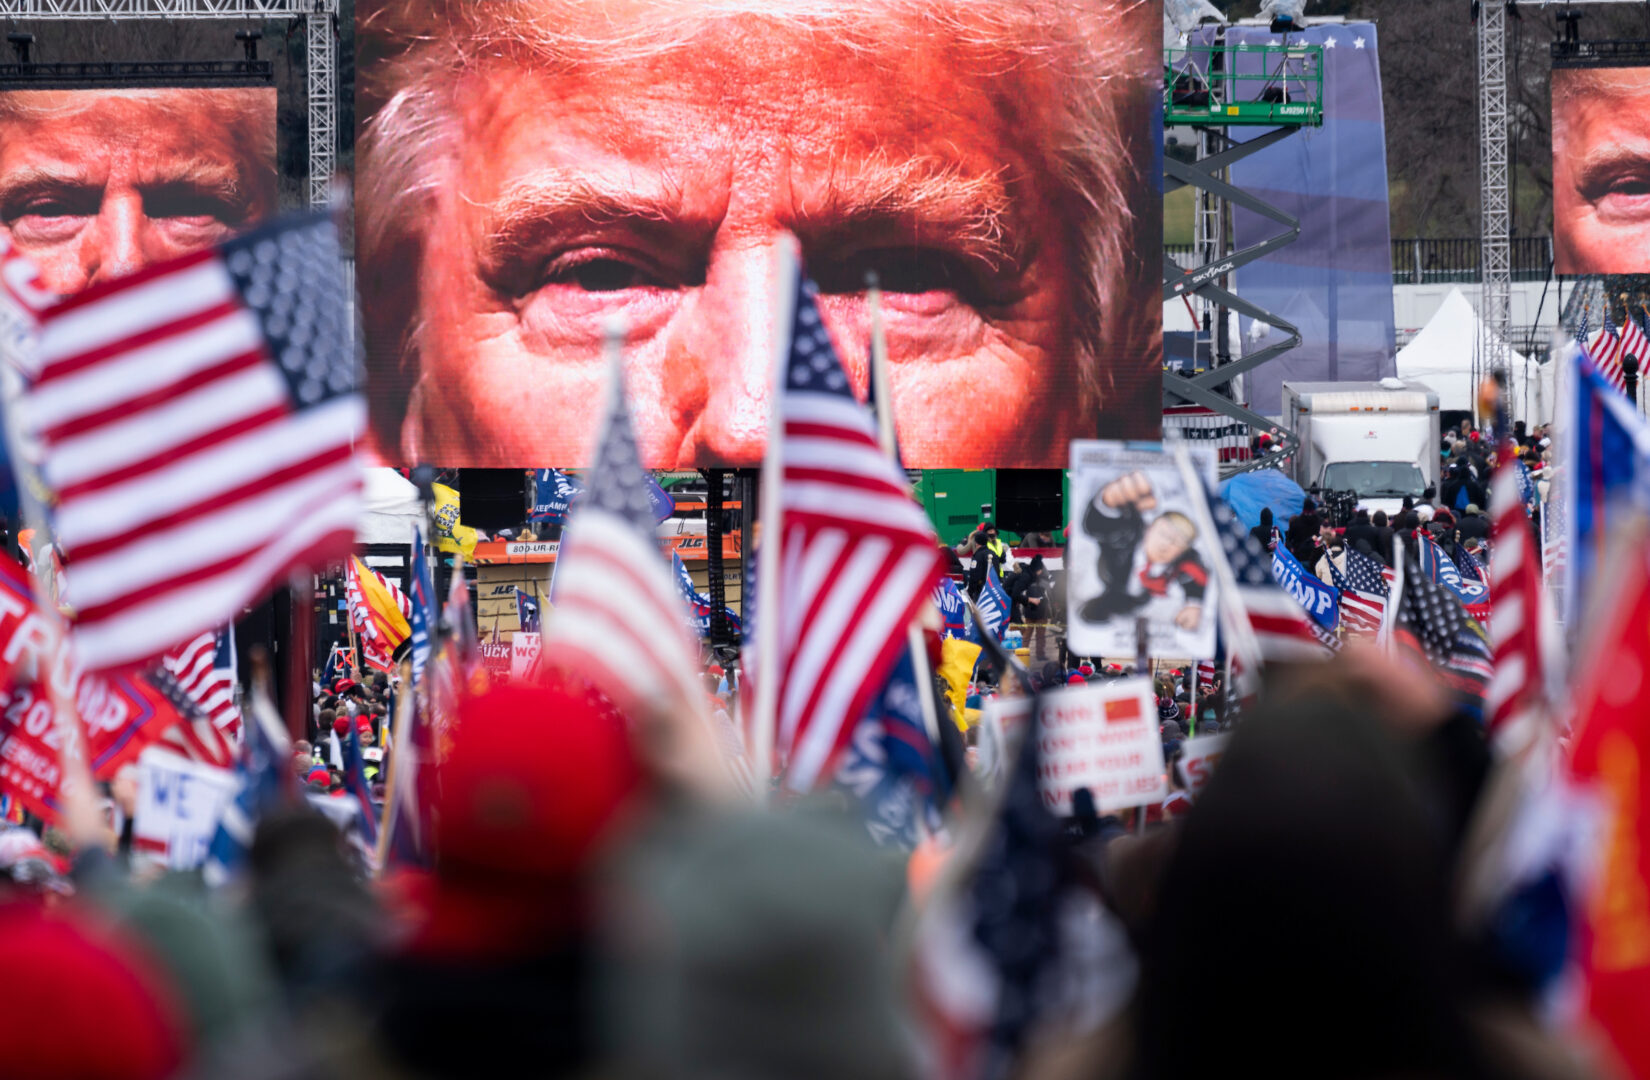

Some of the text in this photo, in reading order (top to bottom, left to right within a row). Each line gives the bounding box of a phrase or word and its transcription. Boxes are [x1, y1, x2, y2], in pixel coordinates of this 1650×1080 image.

[1192, 262, 1235, 283] SKYJACK
[677, 537, 705, 550] JLG
[491, 585, 515, 595] JLG
